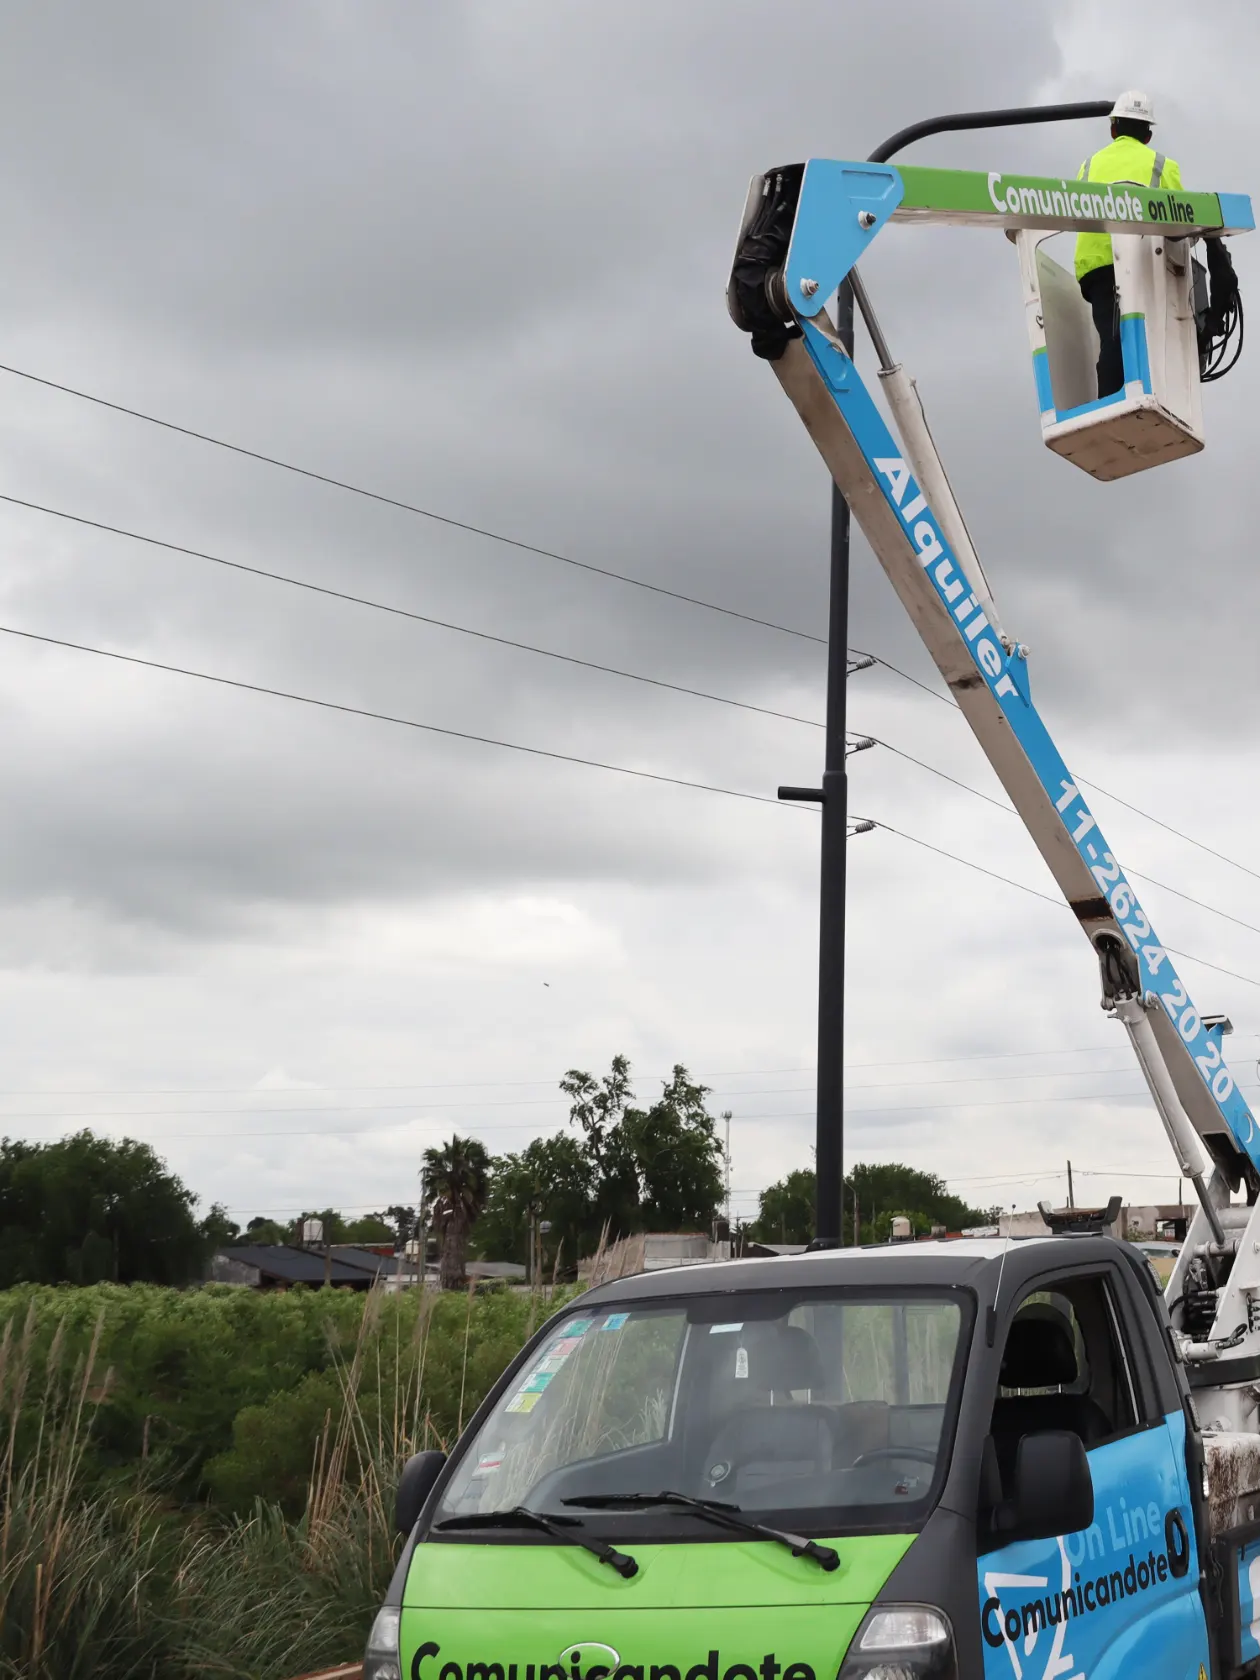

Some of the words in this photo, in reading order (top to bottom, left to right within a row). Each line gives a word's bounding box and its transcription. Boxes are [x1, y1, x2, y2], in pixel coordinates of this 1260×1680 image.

[987, 172, 1143, 221] Comunicandote
[1148, 200, 1167, 222] on
[1168, 195, 1194, 224] line
[872, 457, 1019, 698] Alquiler
[1055, 779, 1168, 976] 11-2624
[1160, 979, 1201, 1044] 20
[1195, 1041, 1234, 1103] 20
[1066, 1523, 1104, 1567] On
[1107, 1498, 1161, 1551] Line
[981, 1551, 1168, 1648] Comunicandote
